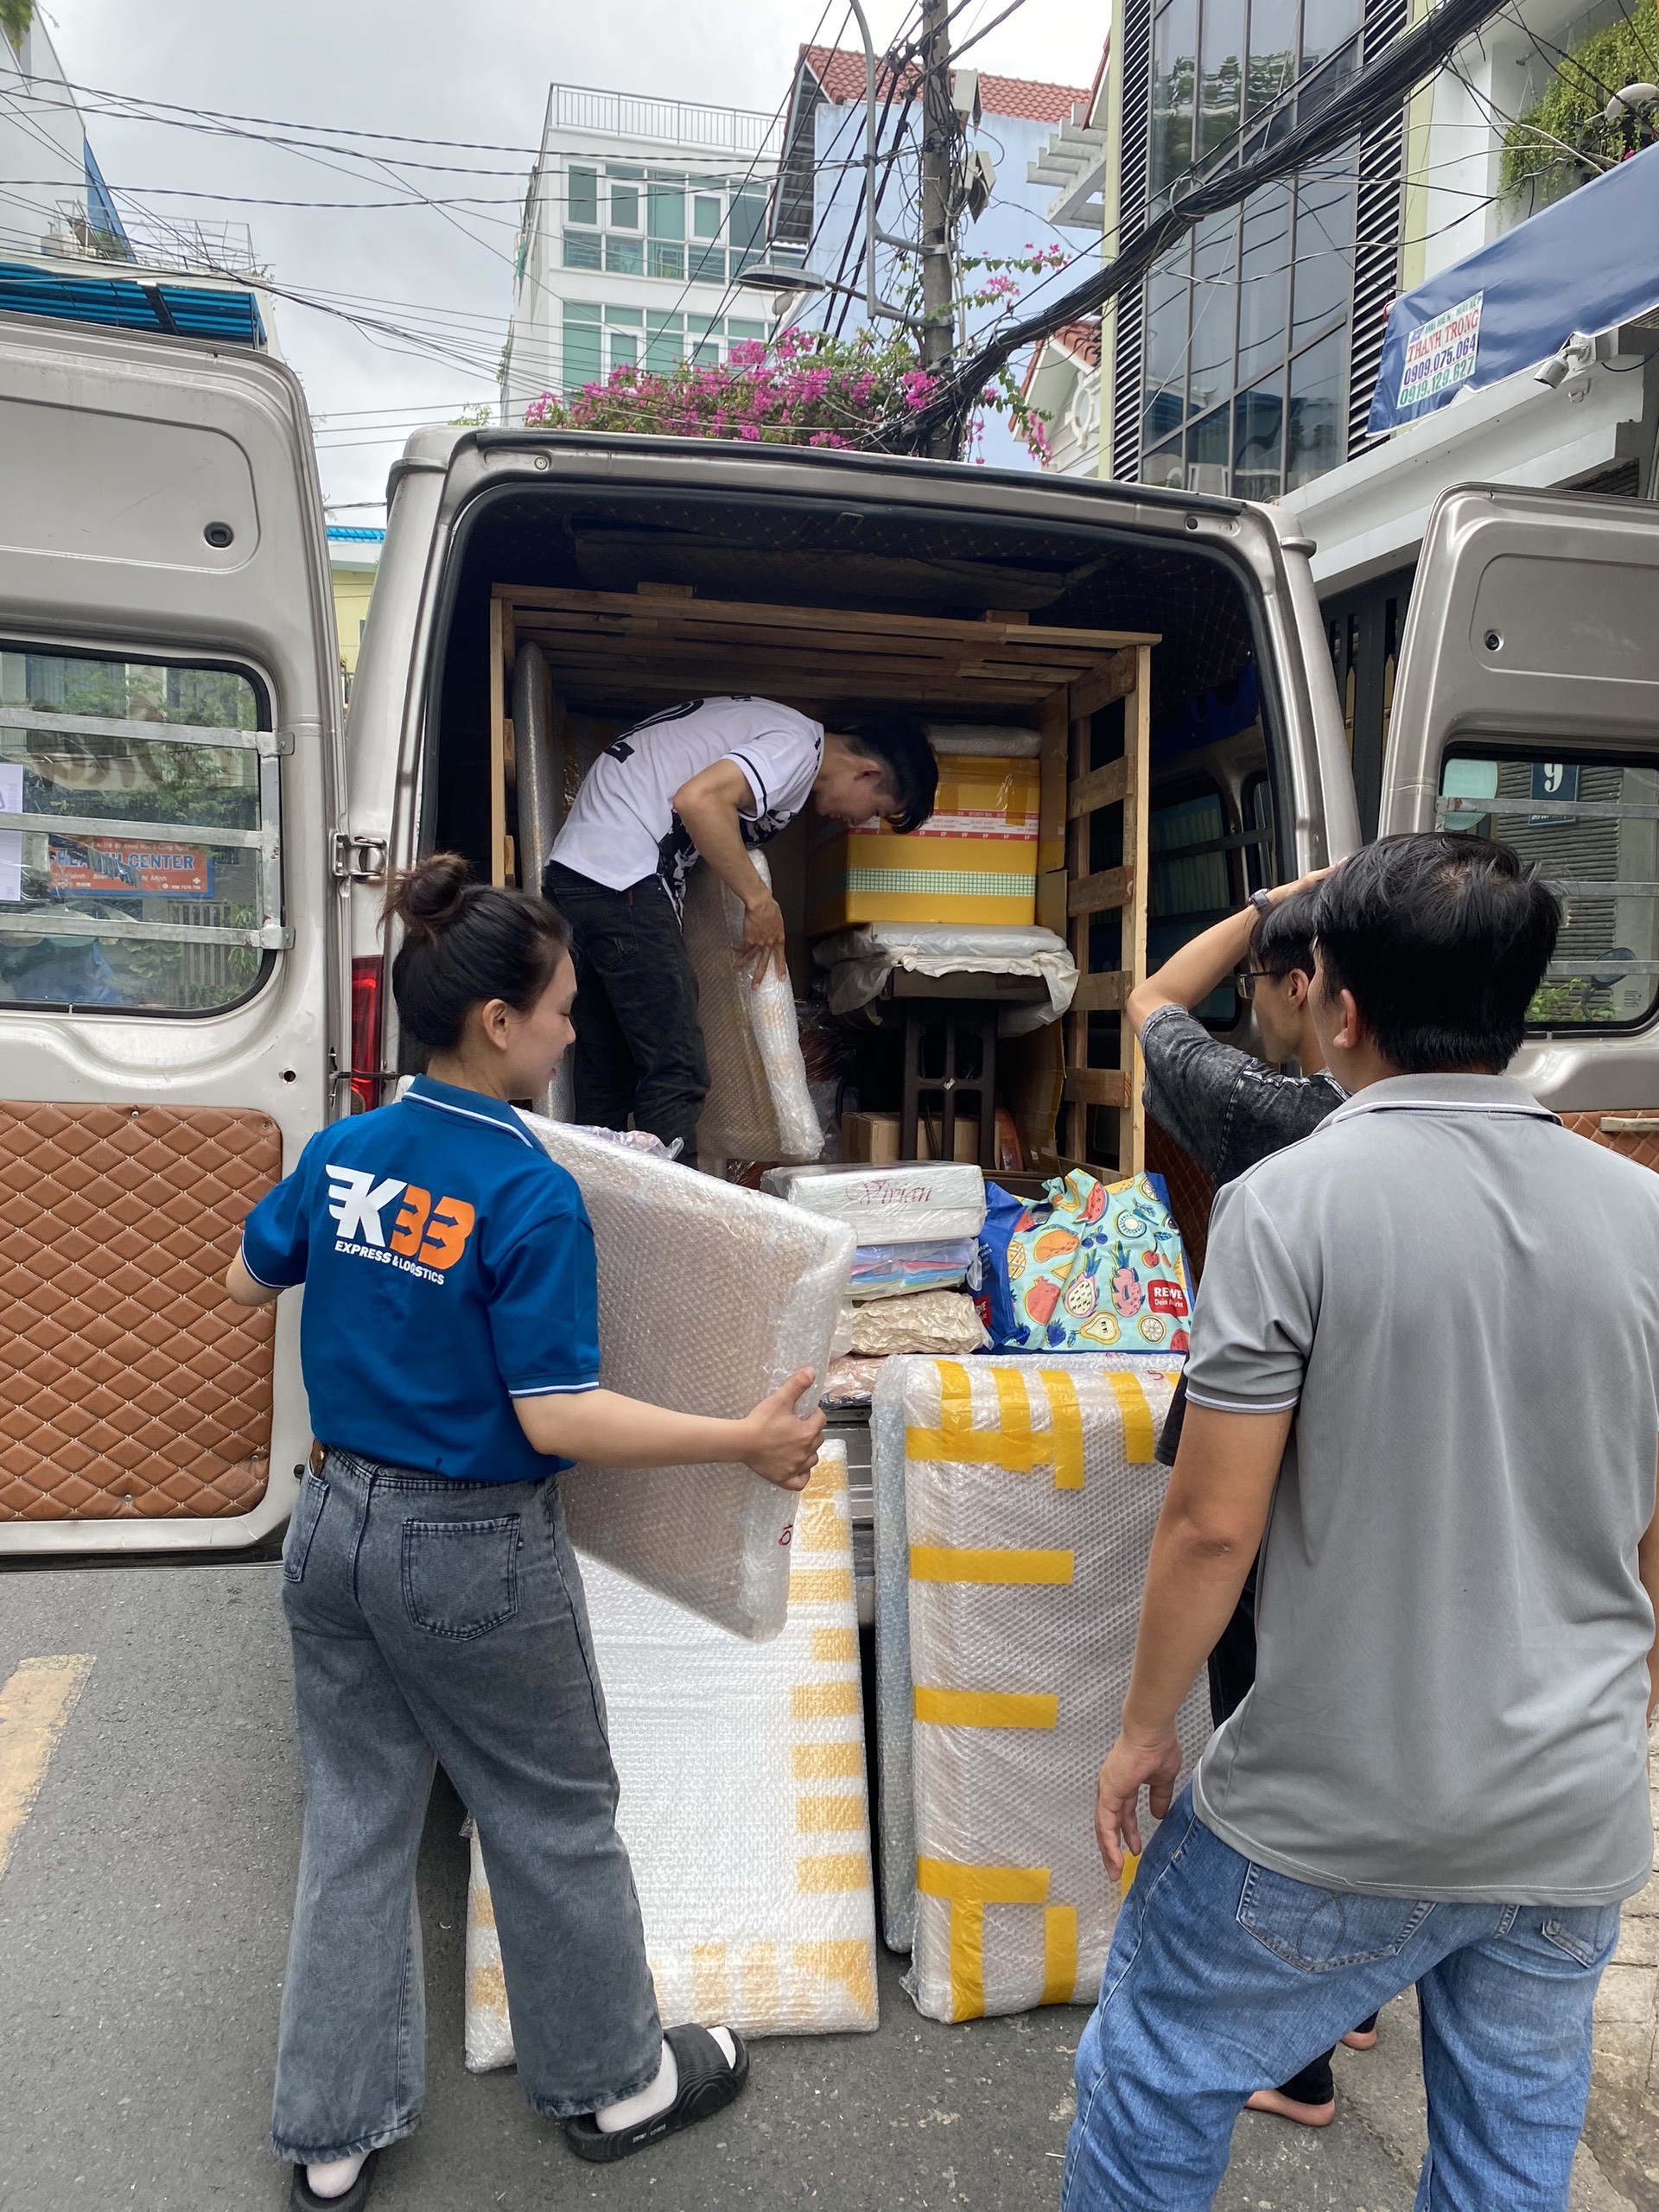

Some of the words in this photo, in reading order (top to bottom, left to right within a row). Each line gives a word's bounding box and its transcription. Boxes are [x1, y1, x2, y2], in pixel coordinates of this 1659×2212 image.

[1403, 333, 1477, 385] 0909.075.064
[1400, 355, 1474, 405] 0919.129.627
[128, 852, 194, 870] CENTER
[334, 1241, 392, 1264] EXPRESS
[398, 1257, 445, 1285] LOGSTICS
[1154, 1287, 1183, 1300] REWE
[1169, 1299, 1184, 1307] Mrkt
